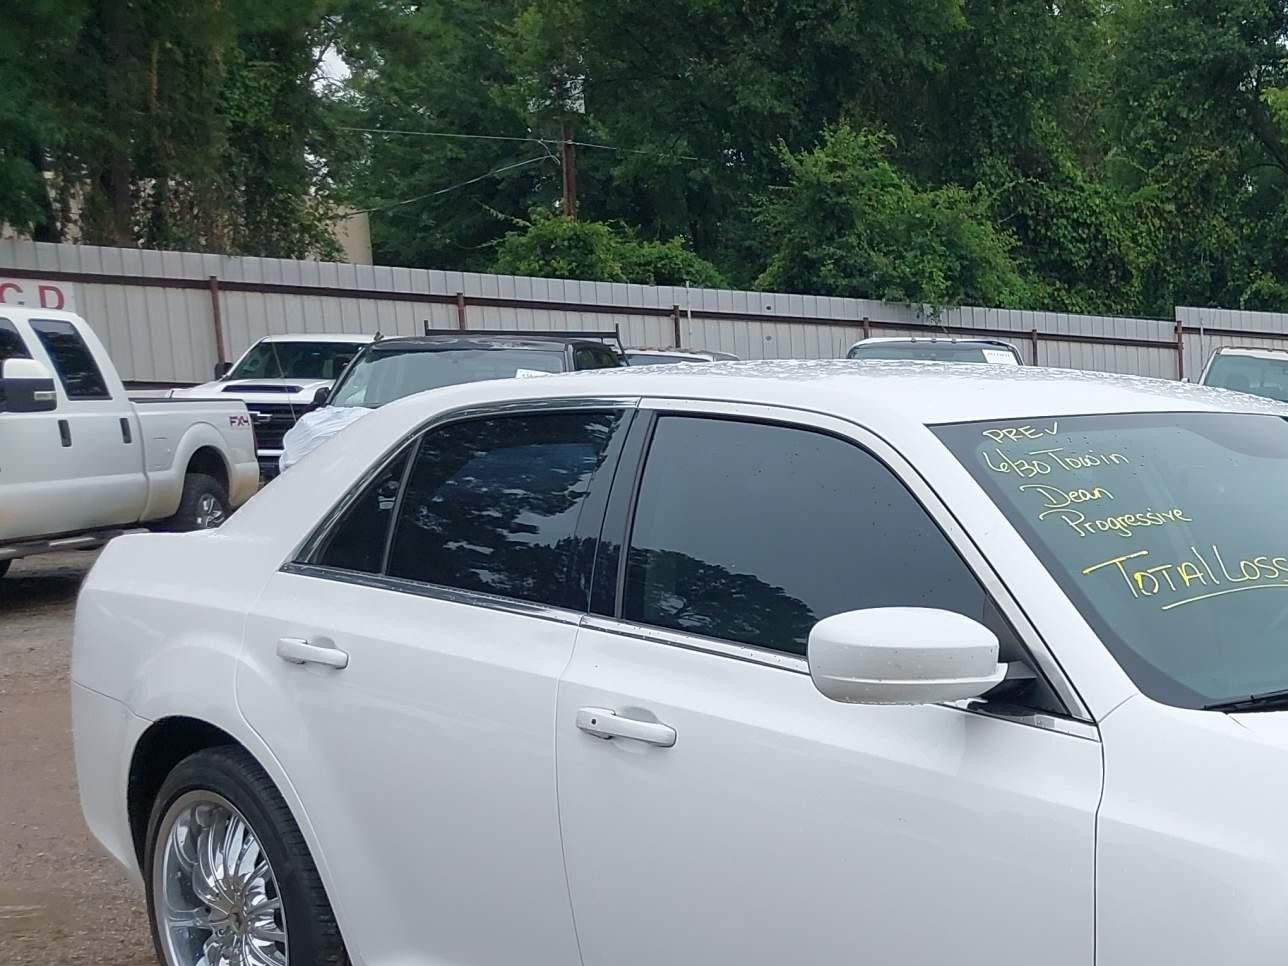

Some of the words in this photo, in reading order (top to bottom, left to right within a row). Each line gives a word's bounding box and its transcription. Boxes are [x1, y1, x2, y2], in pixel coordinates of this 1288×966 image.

[982, 448, 1051, 478] 6/30
[1019, 484, 1115, 508] Dean
[1038, 507, 1193, 537] Progressive
